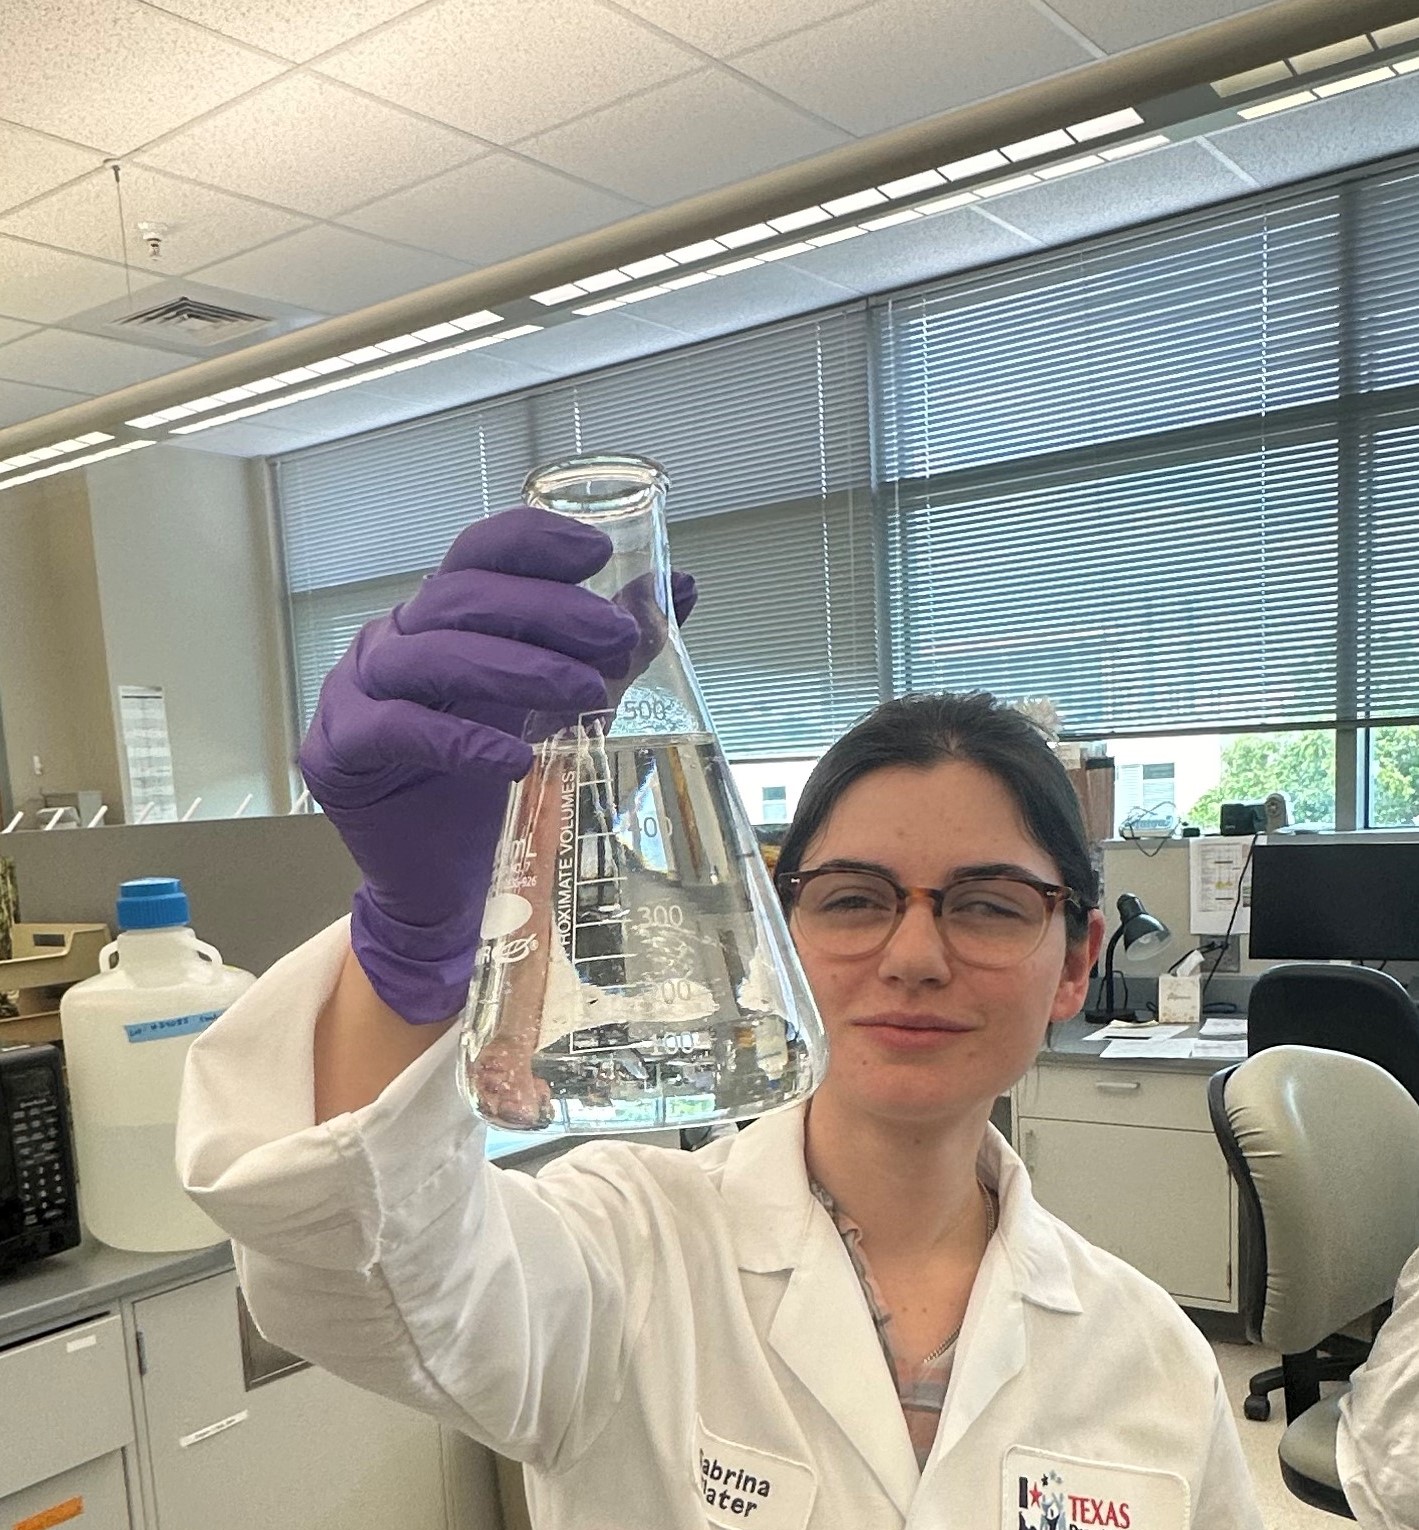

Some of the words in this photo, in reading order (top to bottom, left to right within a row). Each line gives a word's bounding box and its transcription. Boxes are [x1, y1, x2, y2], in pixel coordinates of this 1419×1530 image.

[624, 701, 667, 721] 500
[559, 770, 577, 855] VOLUMES
[637, 904, 683, 926] 300
[702, 1476, 758, 1518] later
[1067, 1494, 1131, 1529] TEXAS
